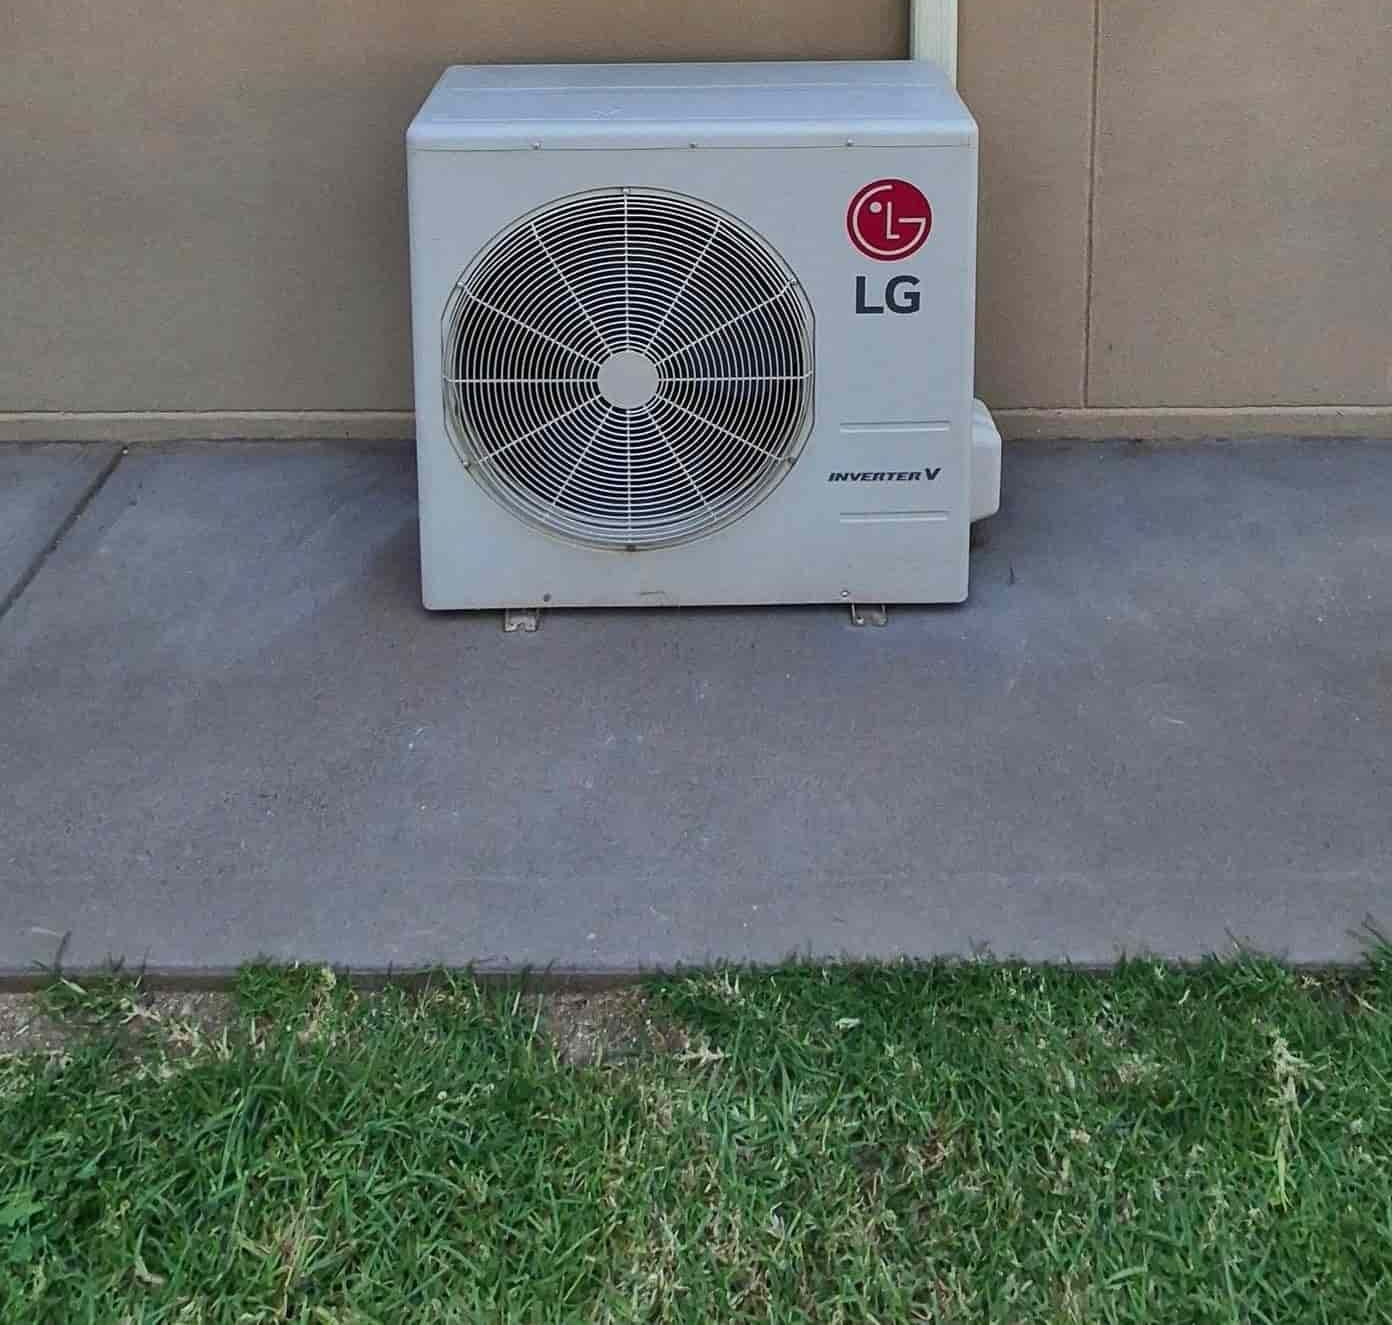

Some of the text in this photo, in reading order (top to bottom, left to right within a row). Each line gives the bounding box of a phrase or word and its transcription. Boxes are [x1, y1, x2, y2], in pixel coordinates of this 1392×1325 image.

[855, 275, 921, 314] LG
[827, 467, 942, 482] INVERTER V
